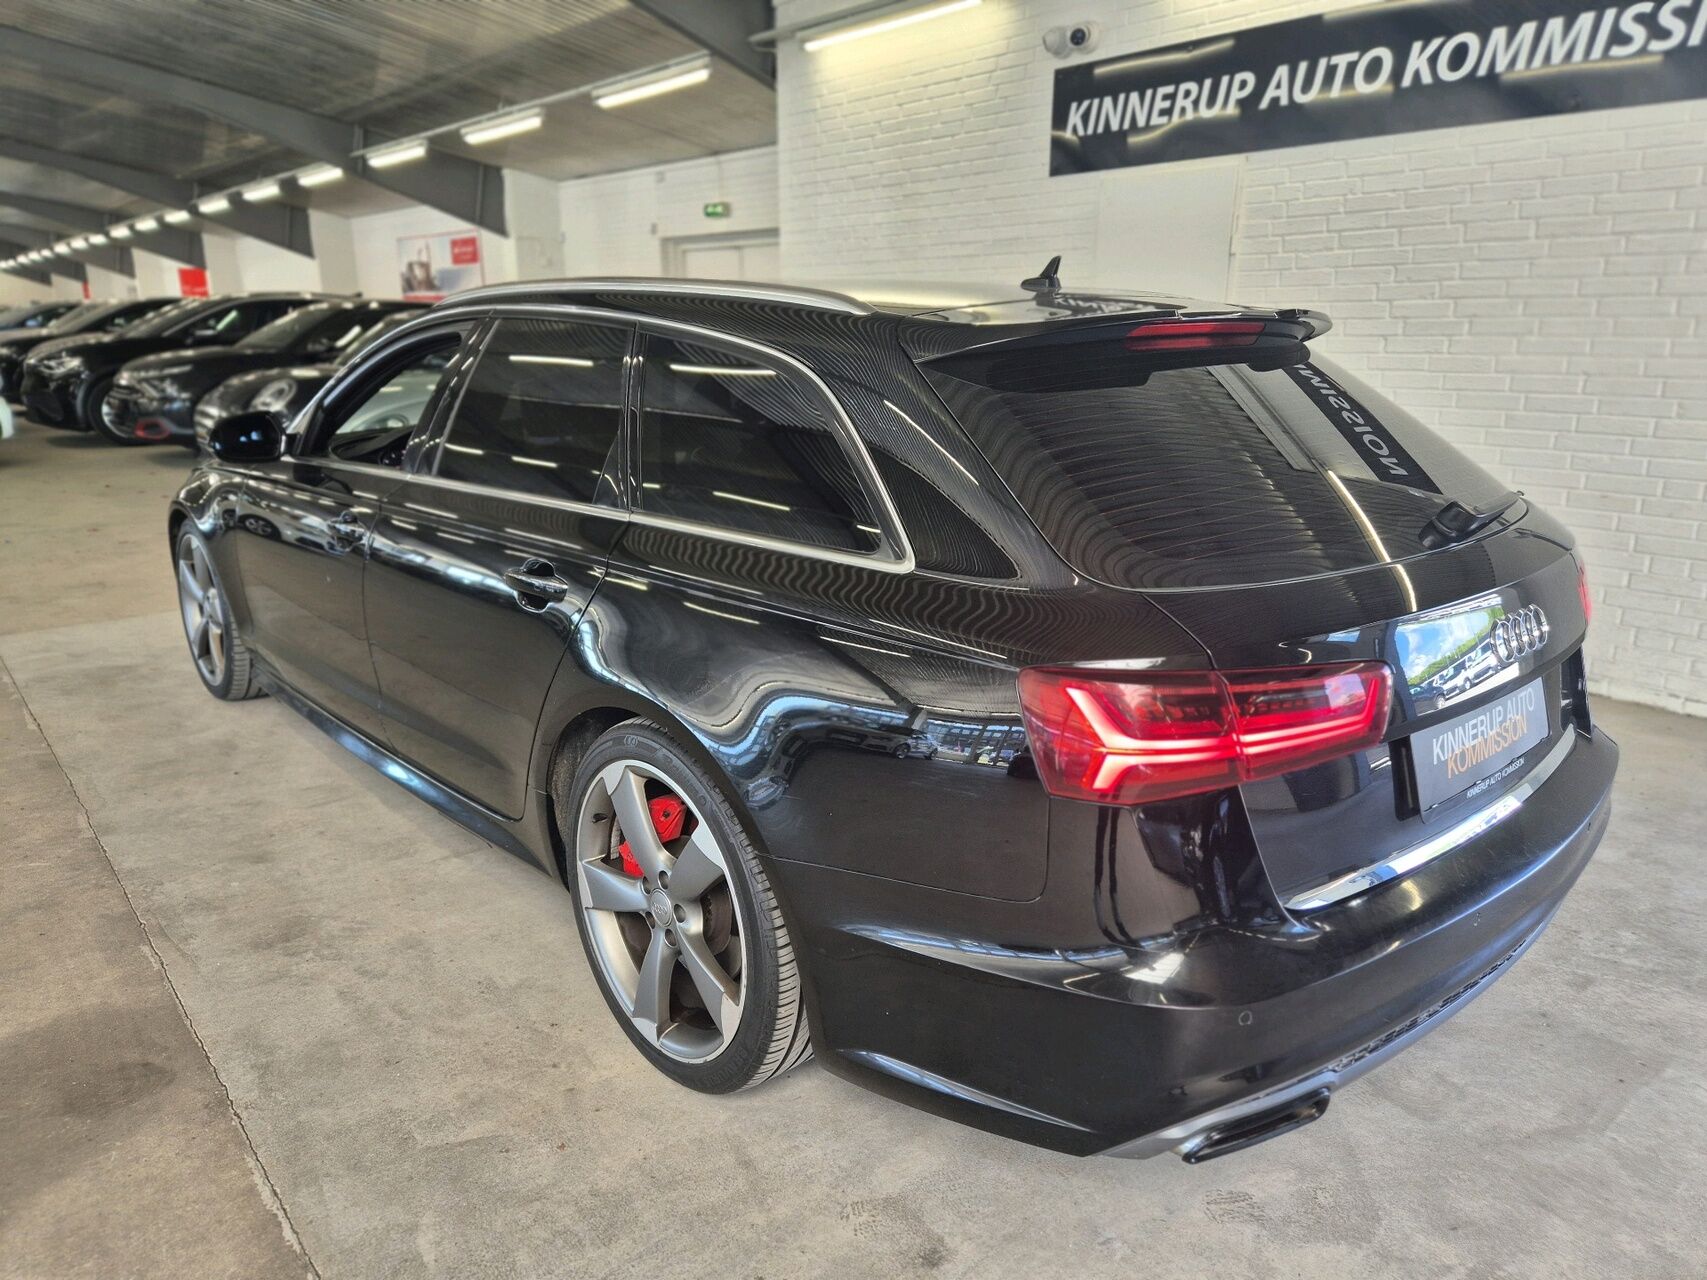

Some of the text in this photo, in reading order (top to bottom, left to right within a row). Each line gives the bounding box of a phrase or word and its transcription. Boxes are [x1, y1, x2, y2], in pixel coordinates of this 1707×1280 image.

[1065, 0, 1707, 137] KINNERUP AUTO KOMMISSI
[1433, 688, 1534, 765] KINNERUP AUTO
[1448, 716, 1527, 778] KOMMISSION
